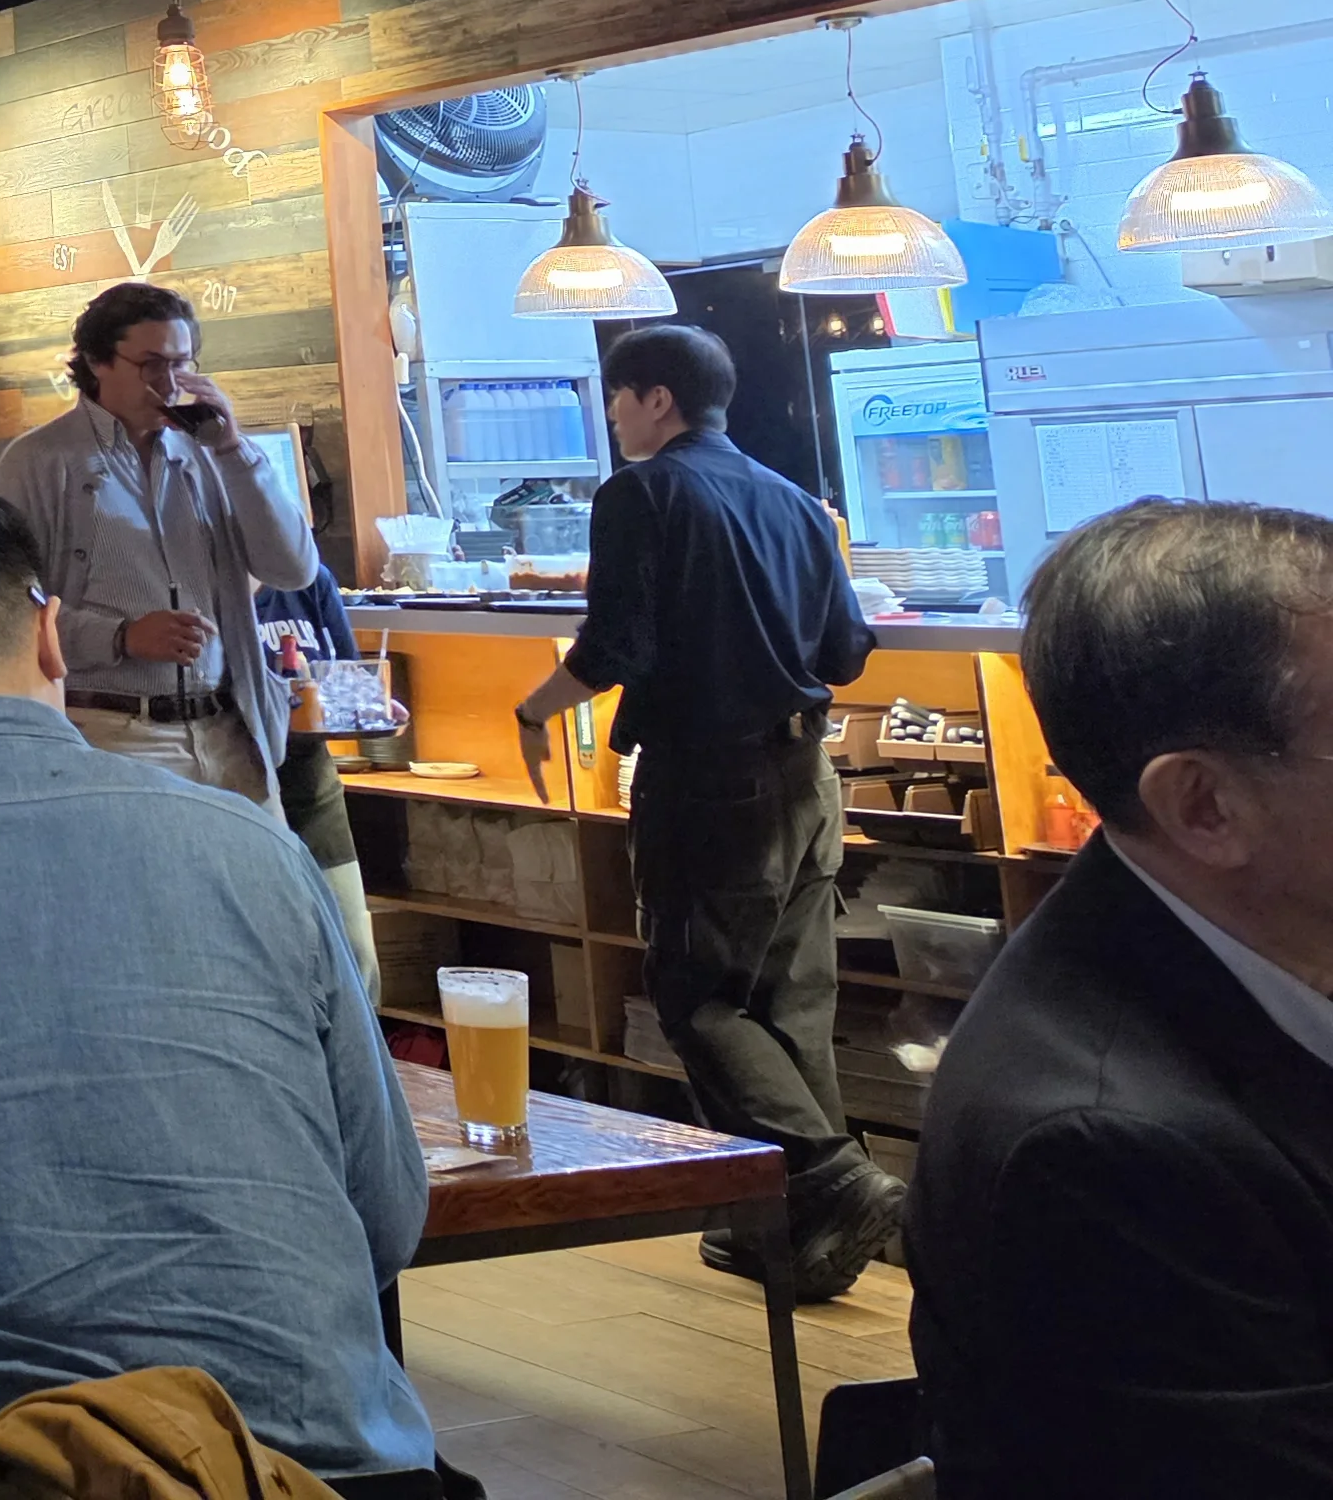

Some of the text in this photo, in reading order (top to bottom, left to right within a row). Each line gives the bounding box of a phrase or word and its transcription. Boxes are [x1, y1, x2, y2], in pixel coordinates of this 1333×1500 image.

[53, 243, 78, 273] EST
[201, 280, 237, 313] 2017
[867, 402, 947, 421] FREETOP
